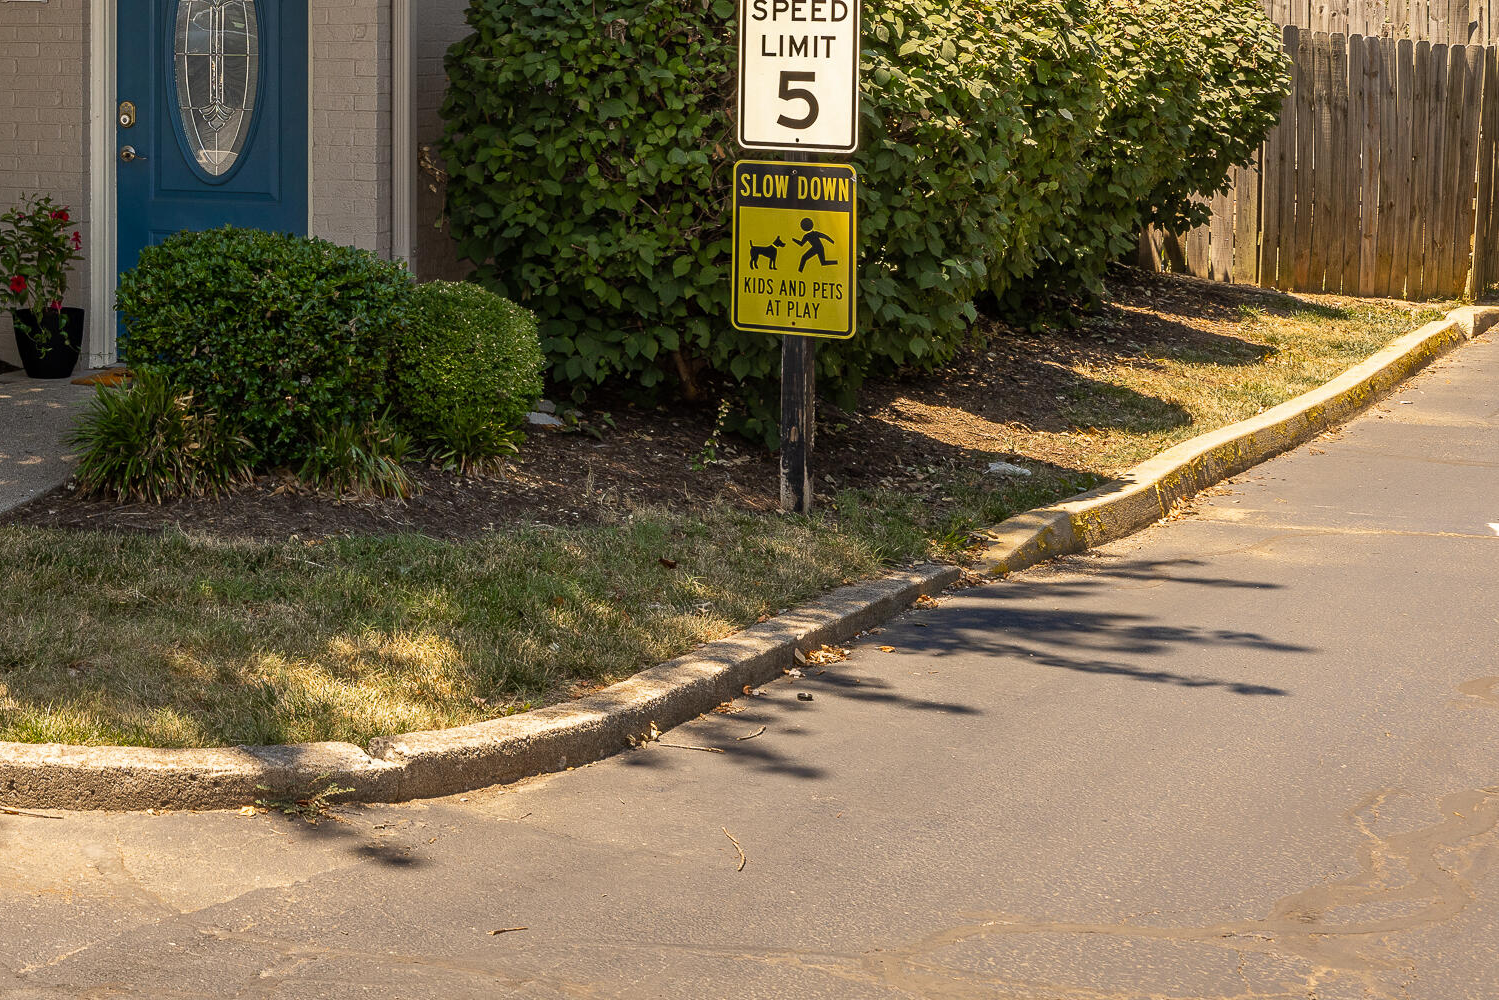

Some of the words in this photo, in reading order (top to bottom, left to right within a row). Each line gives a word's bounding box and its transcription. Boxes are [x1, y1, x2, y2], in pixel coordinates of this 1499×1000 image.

[761, 34, 837, 59] LIMIT
[776, 70, 820, 130] 5
[740, 173, 790, 199] SLOW
[797, 176, 850, 202] DOWN
[744, 276, 774, 295] KIDS
[779, 279, 806, 297] AND
[813, 281, 843, 300] PETS
[765, 299, 781, 316] AT
[787, 300, 821, 320] PLAY
